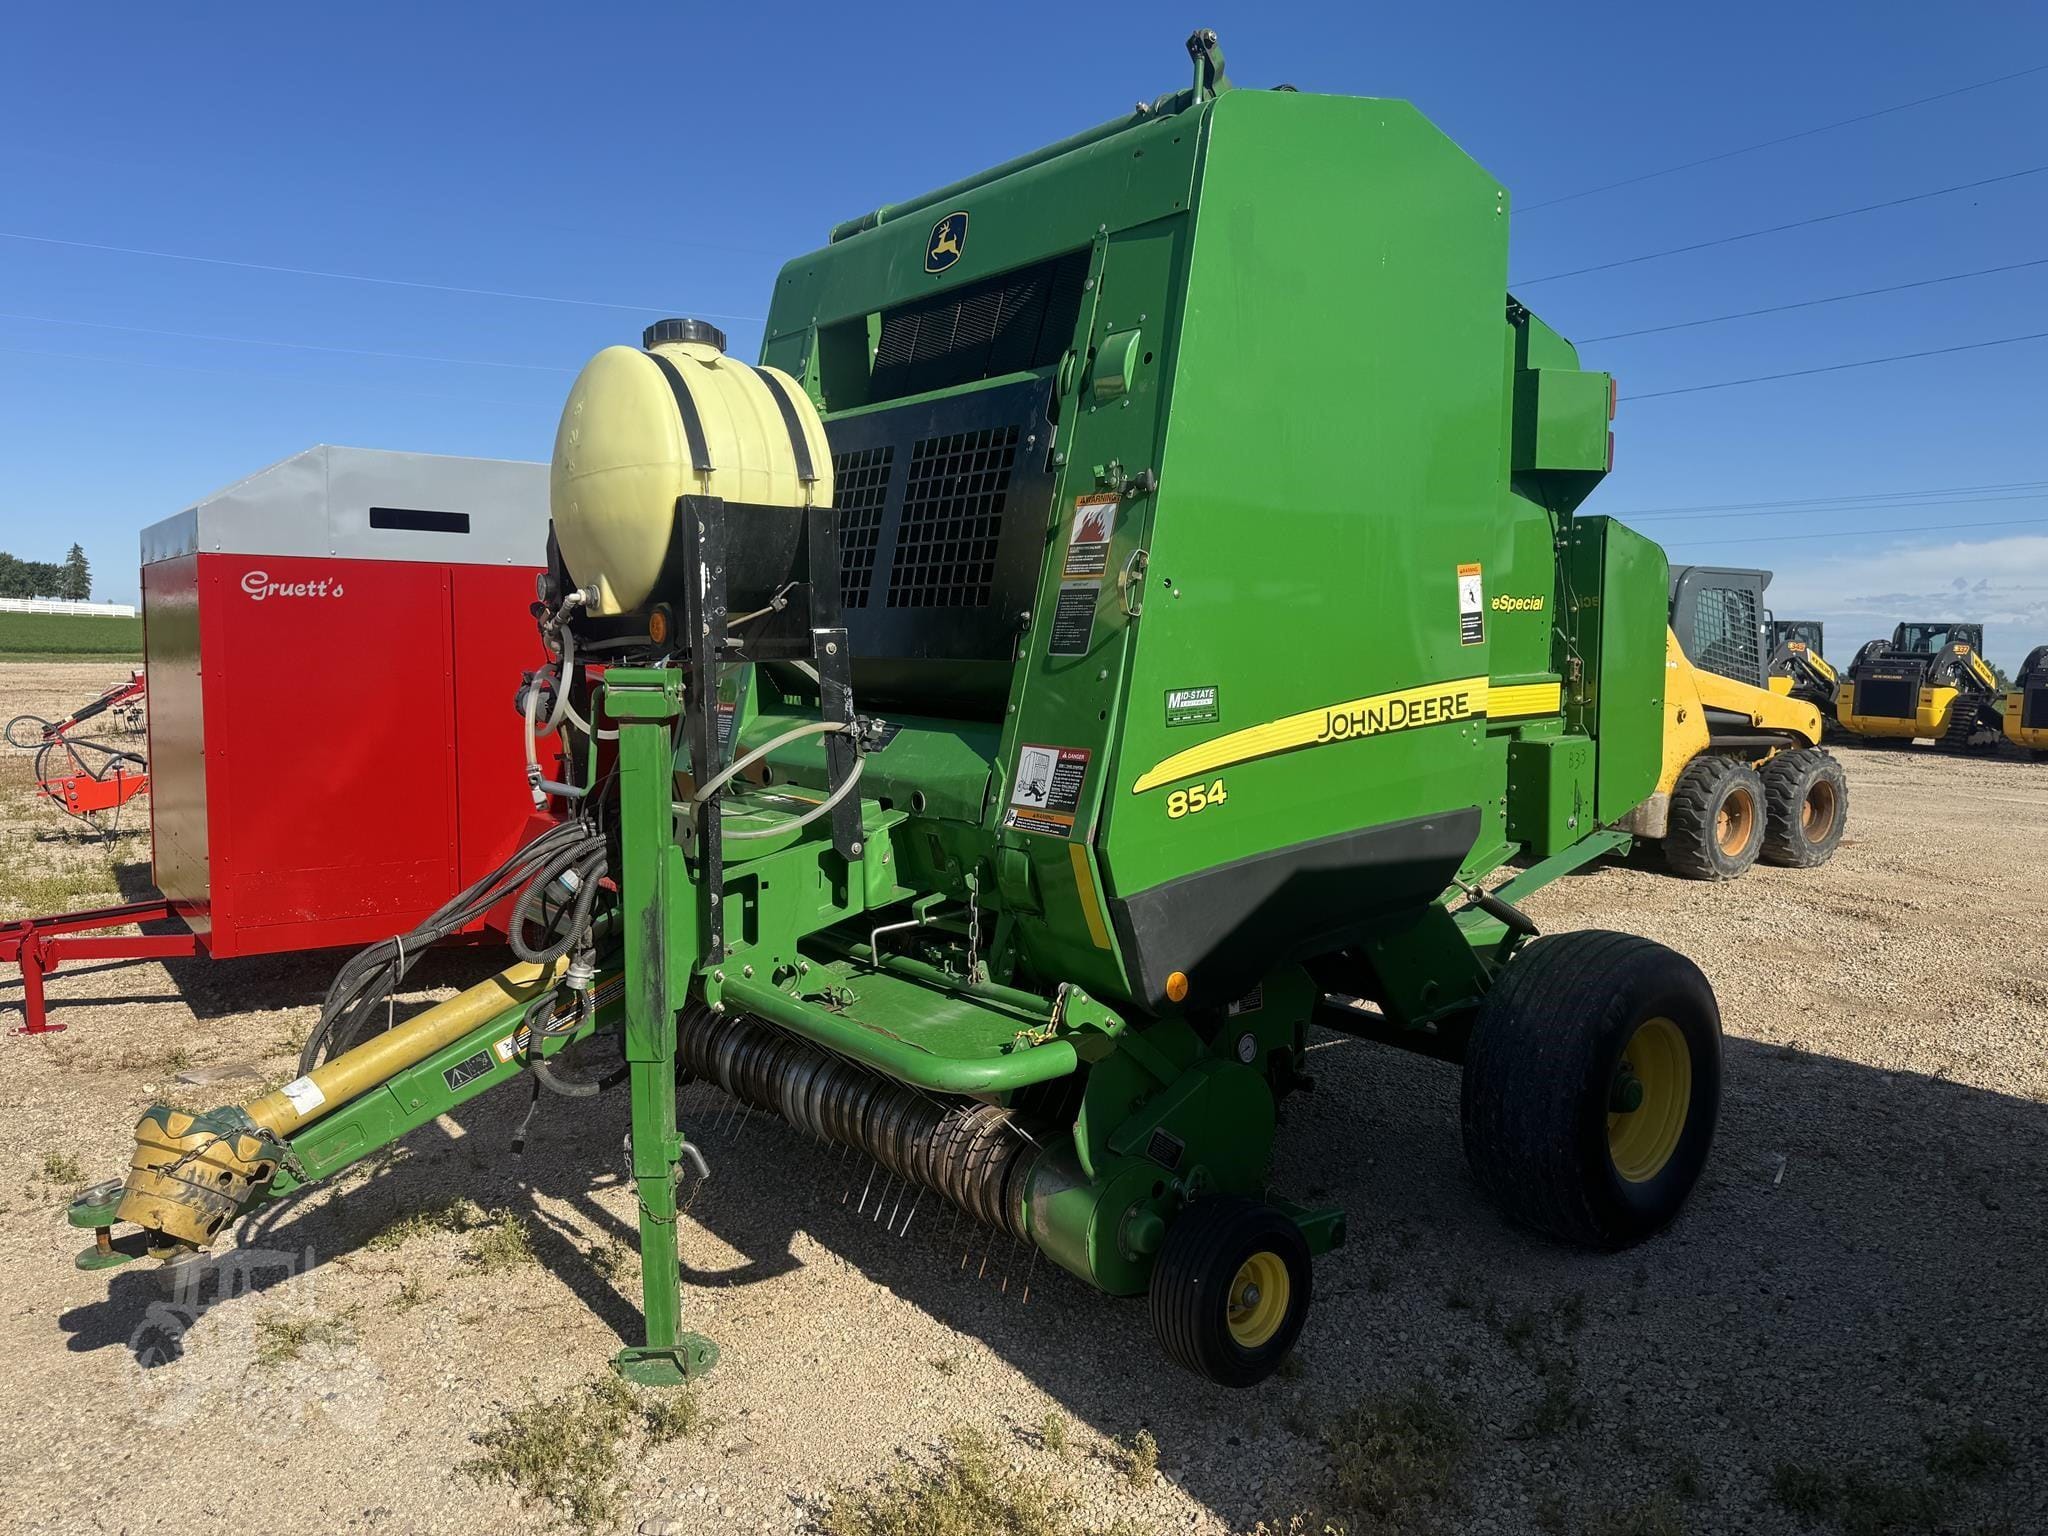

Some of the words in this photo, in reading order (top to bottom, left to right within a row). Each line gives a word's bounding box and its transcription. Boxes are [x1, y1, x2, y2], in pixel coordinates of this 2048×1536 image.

[241, 570, 344, 601] Gruett's
[1491, 593, 1545, 613] eSpecial
[1168, 689, 1215, 709] MID-STATE
[1318, 707, 1383, 740] JOHN
[1388, 692, 1470, 728] DEERE
[1166, 777, 1228, 820] 854
